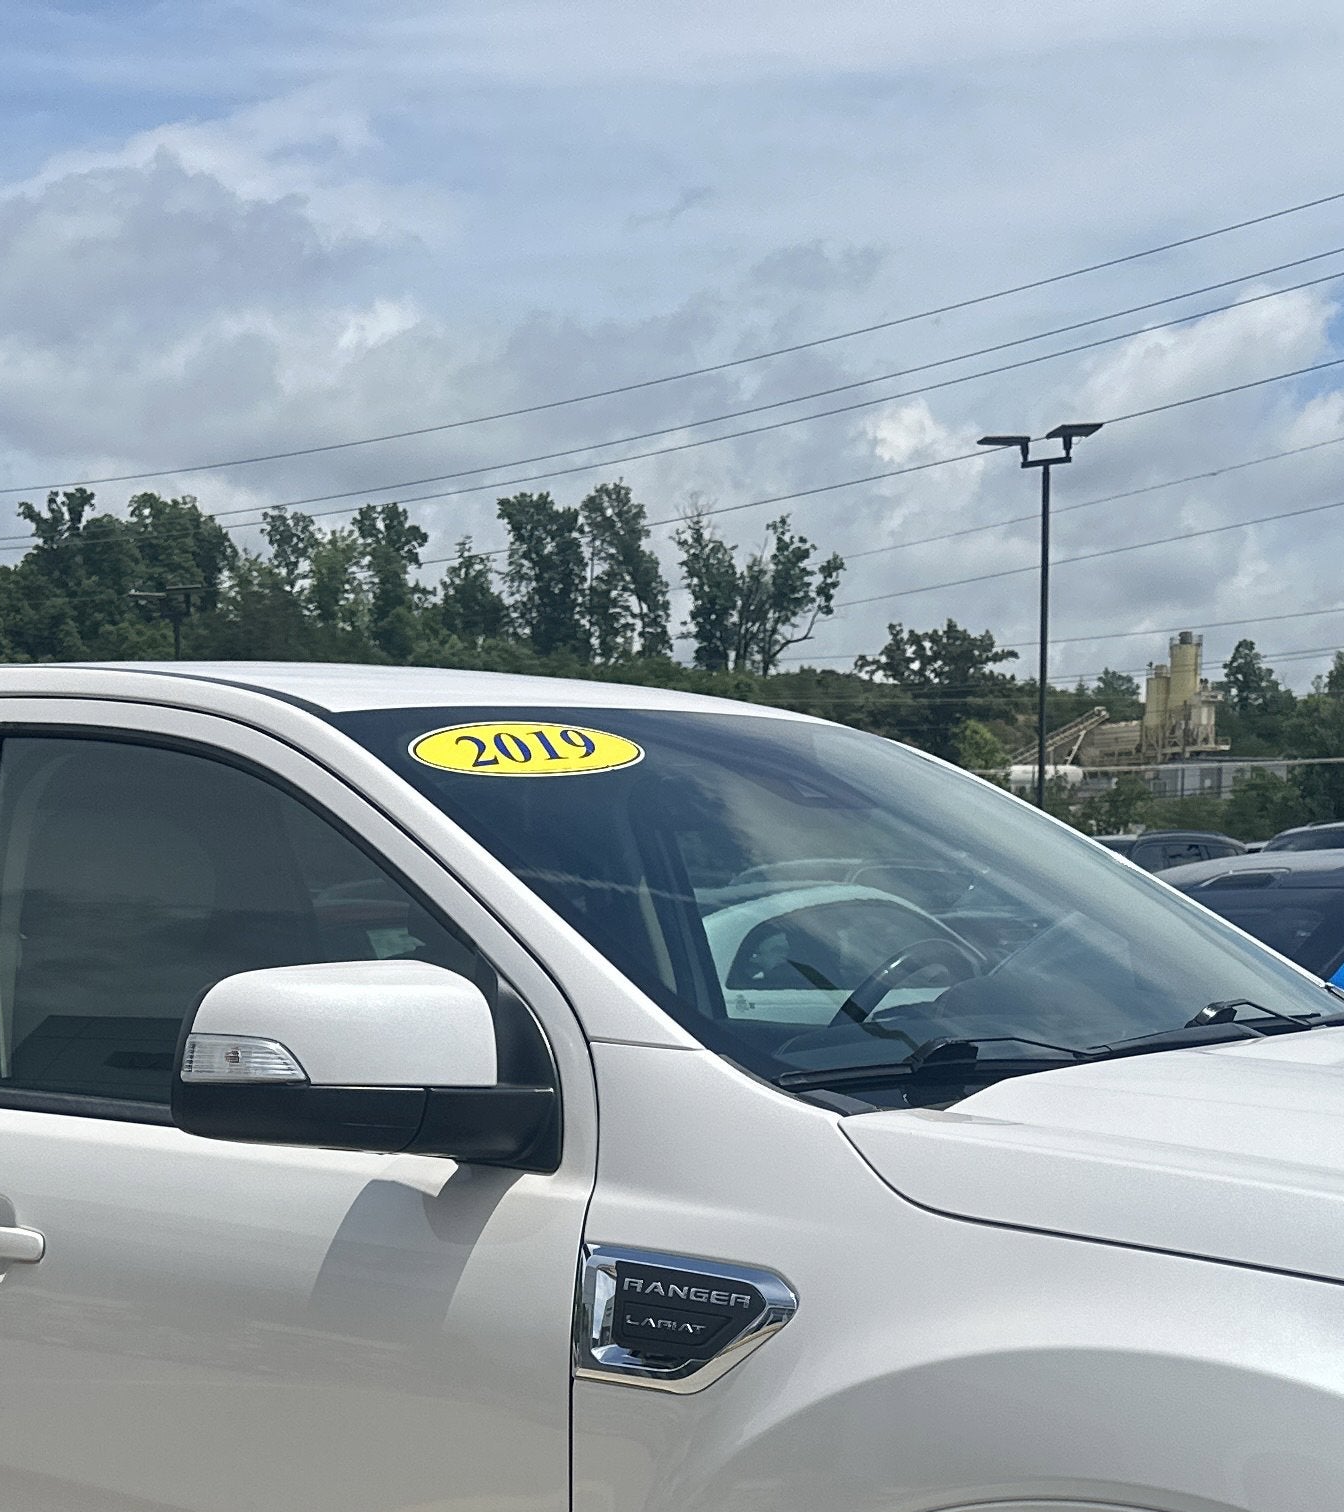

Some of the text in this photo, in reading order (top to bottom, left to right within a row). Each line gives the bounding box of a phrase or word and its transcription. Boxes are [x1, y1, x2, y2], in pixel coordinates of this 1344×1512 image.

[455, 729, 596, 767] 2019
[622, 1277, 751, 1309] RANGER
[625, 1314, 707, 1335] LARIAT
